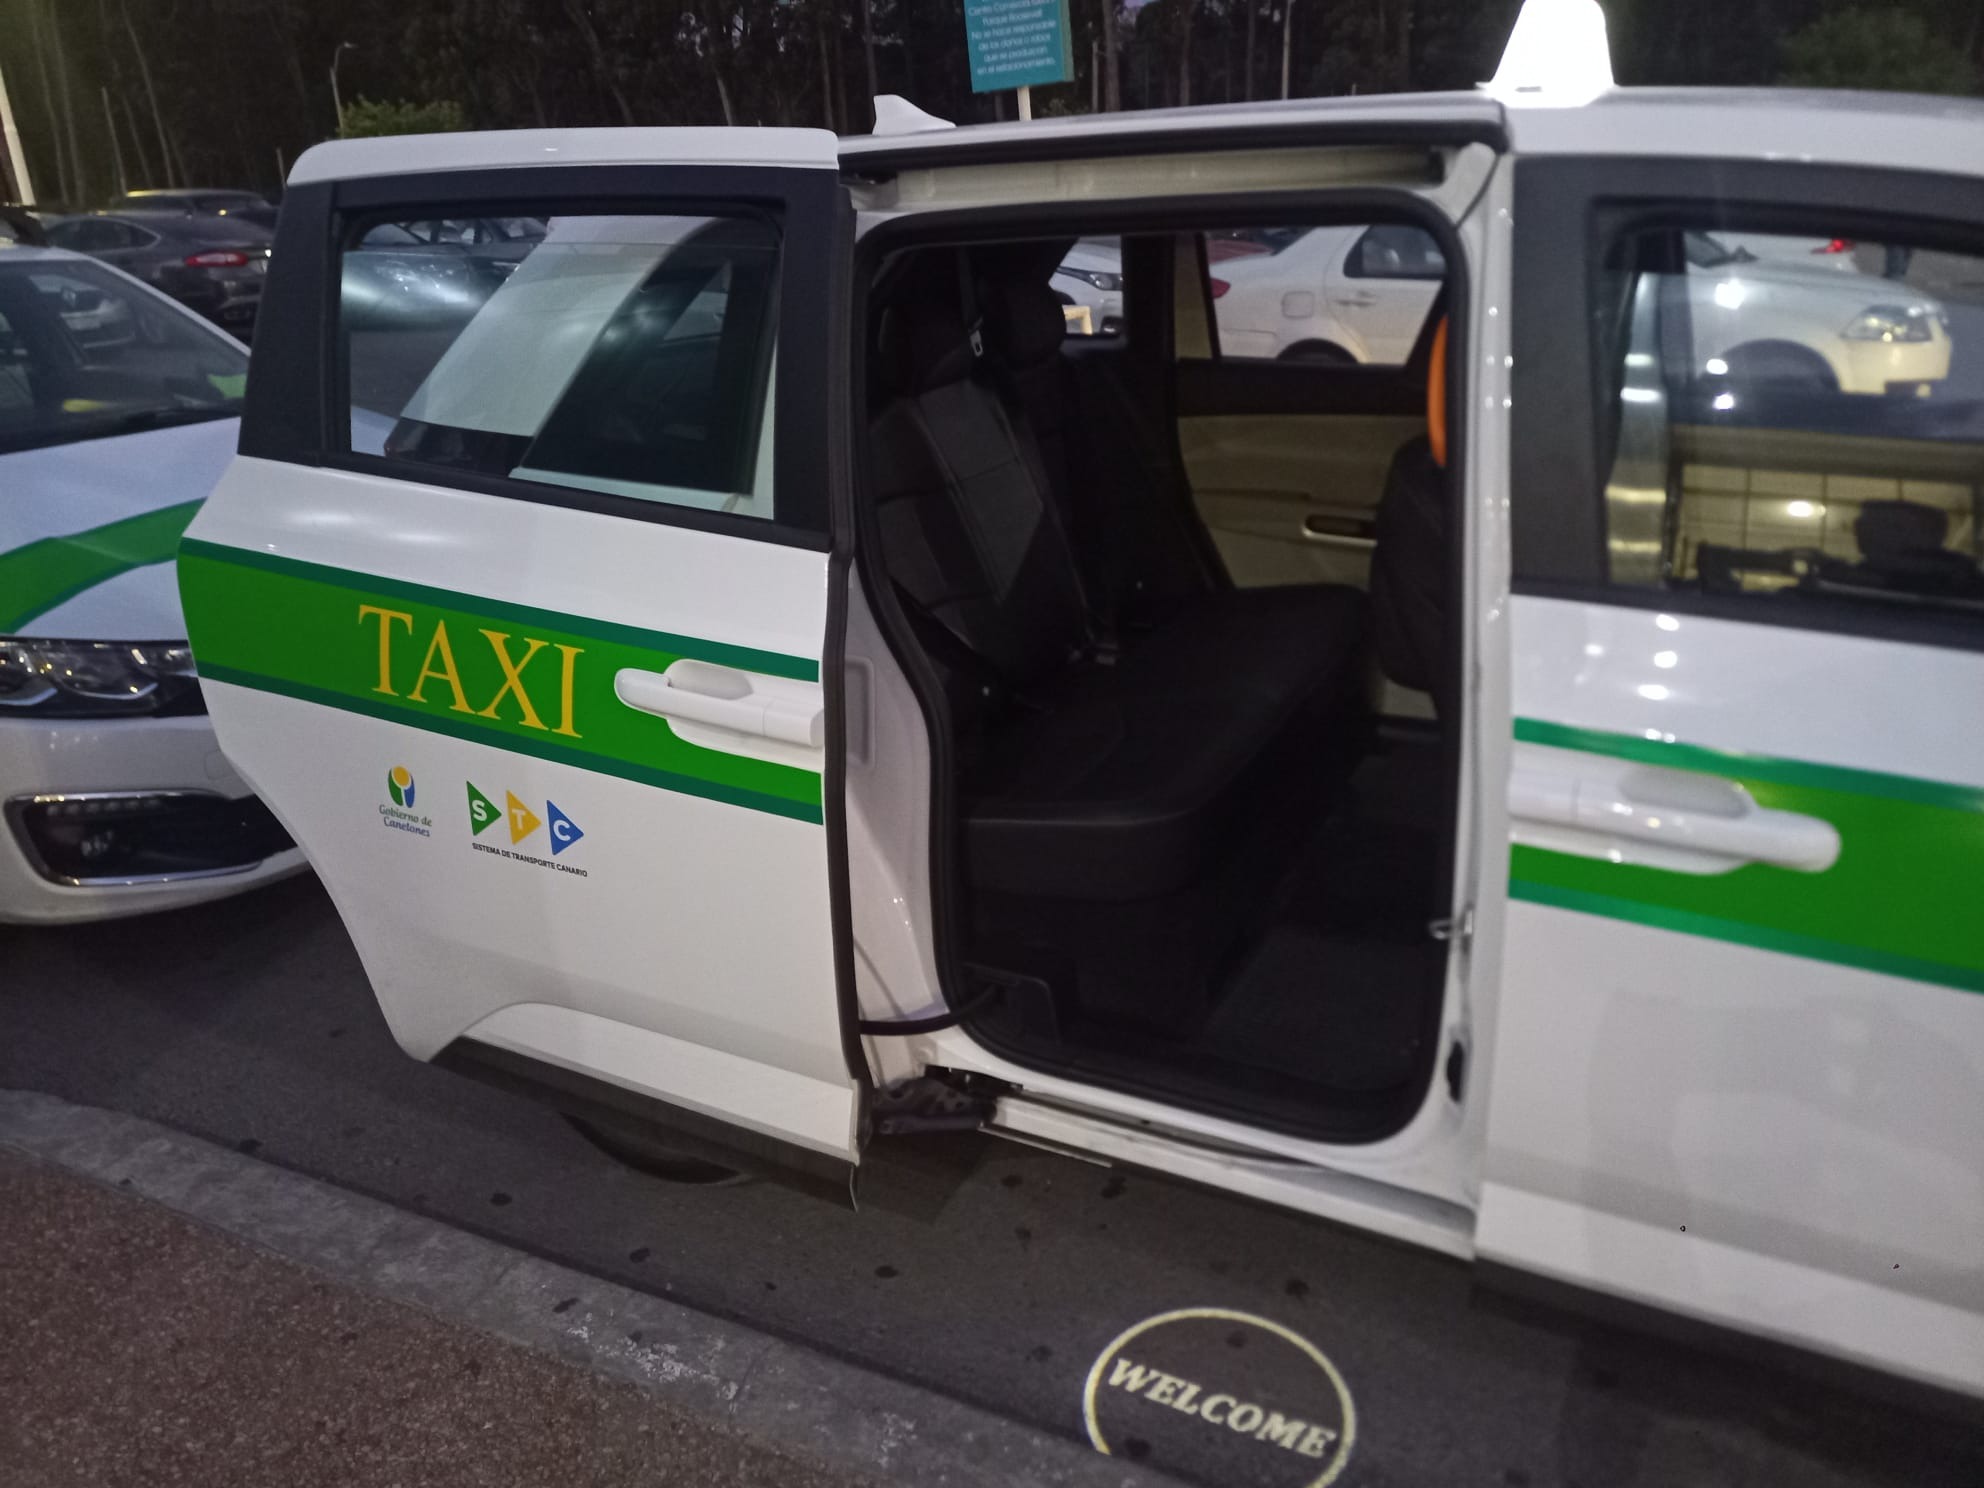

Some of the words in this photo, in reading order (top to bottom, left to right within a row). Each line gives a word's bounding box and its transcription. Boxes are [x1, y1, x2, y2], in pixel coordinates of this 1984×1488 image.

[358, 604, 585, 739] TAXI
[379, 804, 420, 824] Gobierno
[421, 815, 432, 827] de
[384, 816, 431, 838] Canelones
[472, 842, 501, 855] SISTEMA
[502, 849, 512, 859] DE
[513, 852, 555, 870] TRANSPORTE
[556, 862, 588, 878] CANARIO
[1108, 1357, 1337, 1459] WELCOME
